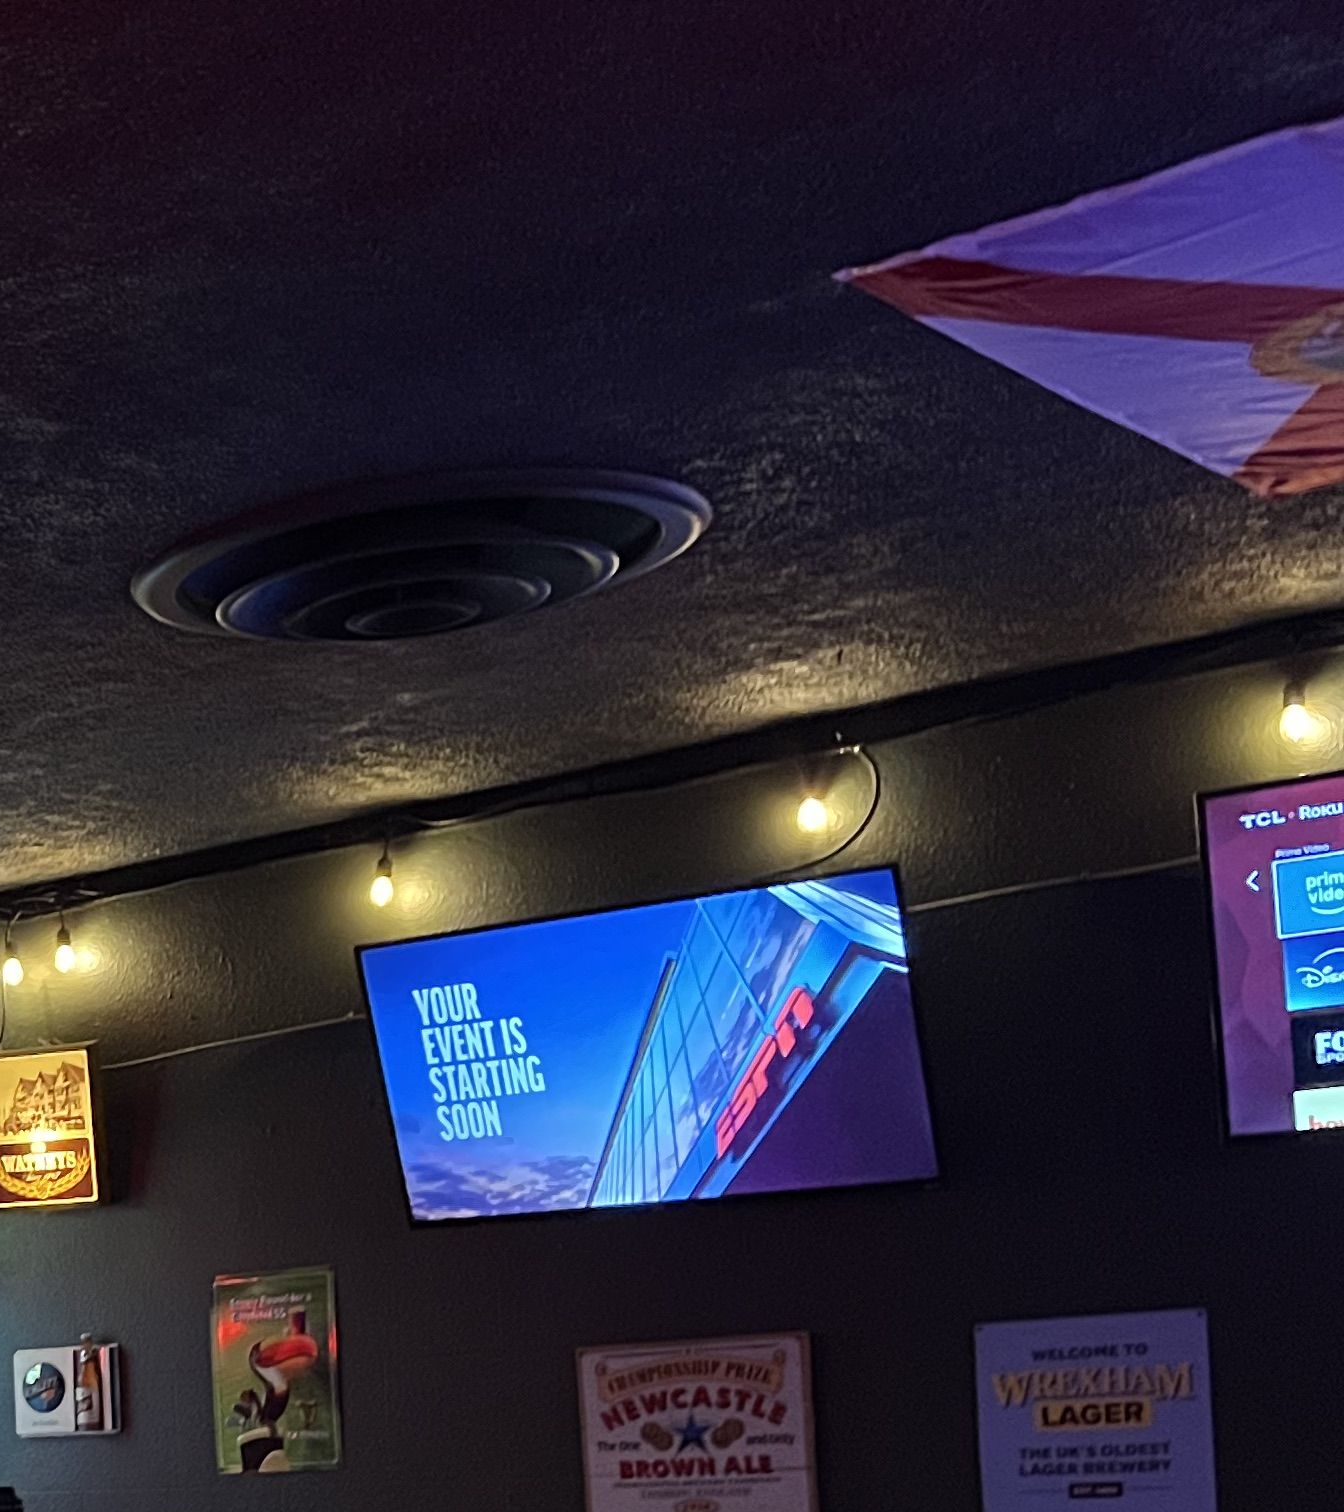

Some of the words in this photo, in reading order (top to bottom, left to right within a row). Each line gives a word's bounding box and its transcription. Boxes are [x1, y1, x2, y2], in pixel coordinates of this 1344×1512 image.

[1239, 811, 1286, 830] TCL
[1306, 871, 1344, 892] prim
[412, 982, 481, 1026] YOUR
[420, 1019, 496, 1066] EVENT
[499, 1016, 528, 1057] IS
[429, 1055, 546, 1104] STARTING
[715, 986, 815, 1160] ESPN
[436, 1100, 503, 1143] SOON
[1, 1150, 78, 1173] WATYS
[1031, 1345, 1119, 1362] WELCOME
[1124, 1343, 1148, 1356] TO
[608, 1359, 721, 1393] CHAMPIONSHIP
[725, 1360, 772, 1385] PRIZE
[994, 1362, 1192, 1407] WREXHAM
[600, 1386, 788, 1431] NEWCASTLE
[1041, 1402, 1144, 1427] LAGER
[1020, 1447, 1051, 1460] THE
[1057, 1444, 1097, 1459] UK'S
[1101, 1441, 1172, 1458] OLDEST
[619, 1456, 716, 1480] BROWN
[724, 1454, 774, 1475] ALE
[1019, 1462, 1079, 1477] LAGER
[1083, 1458, 1173, 1475] BREWERY
